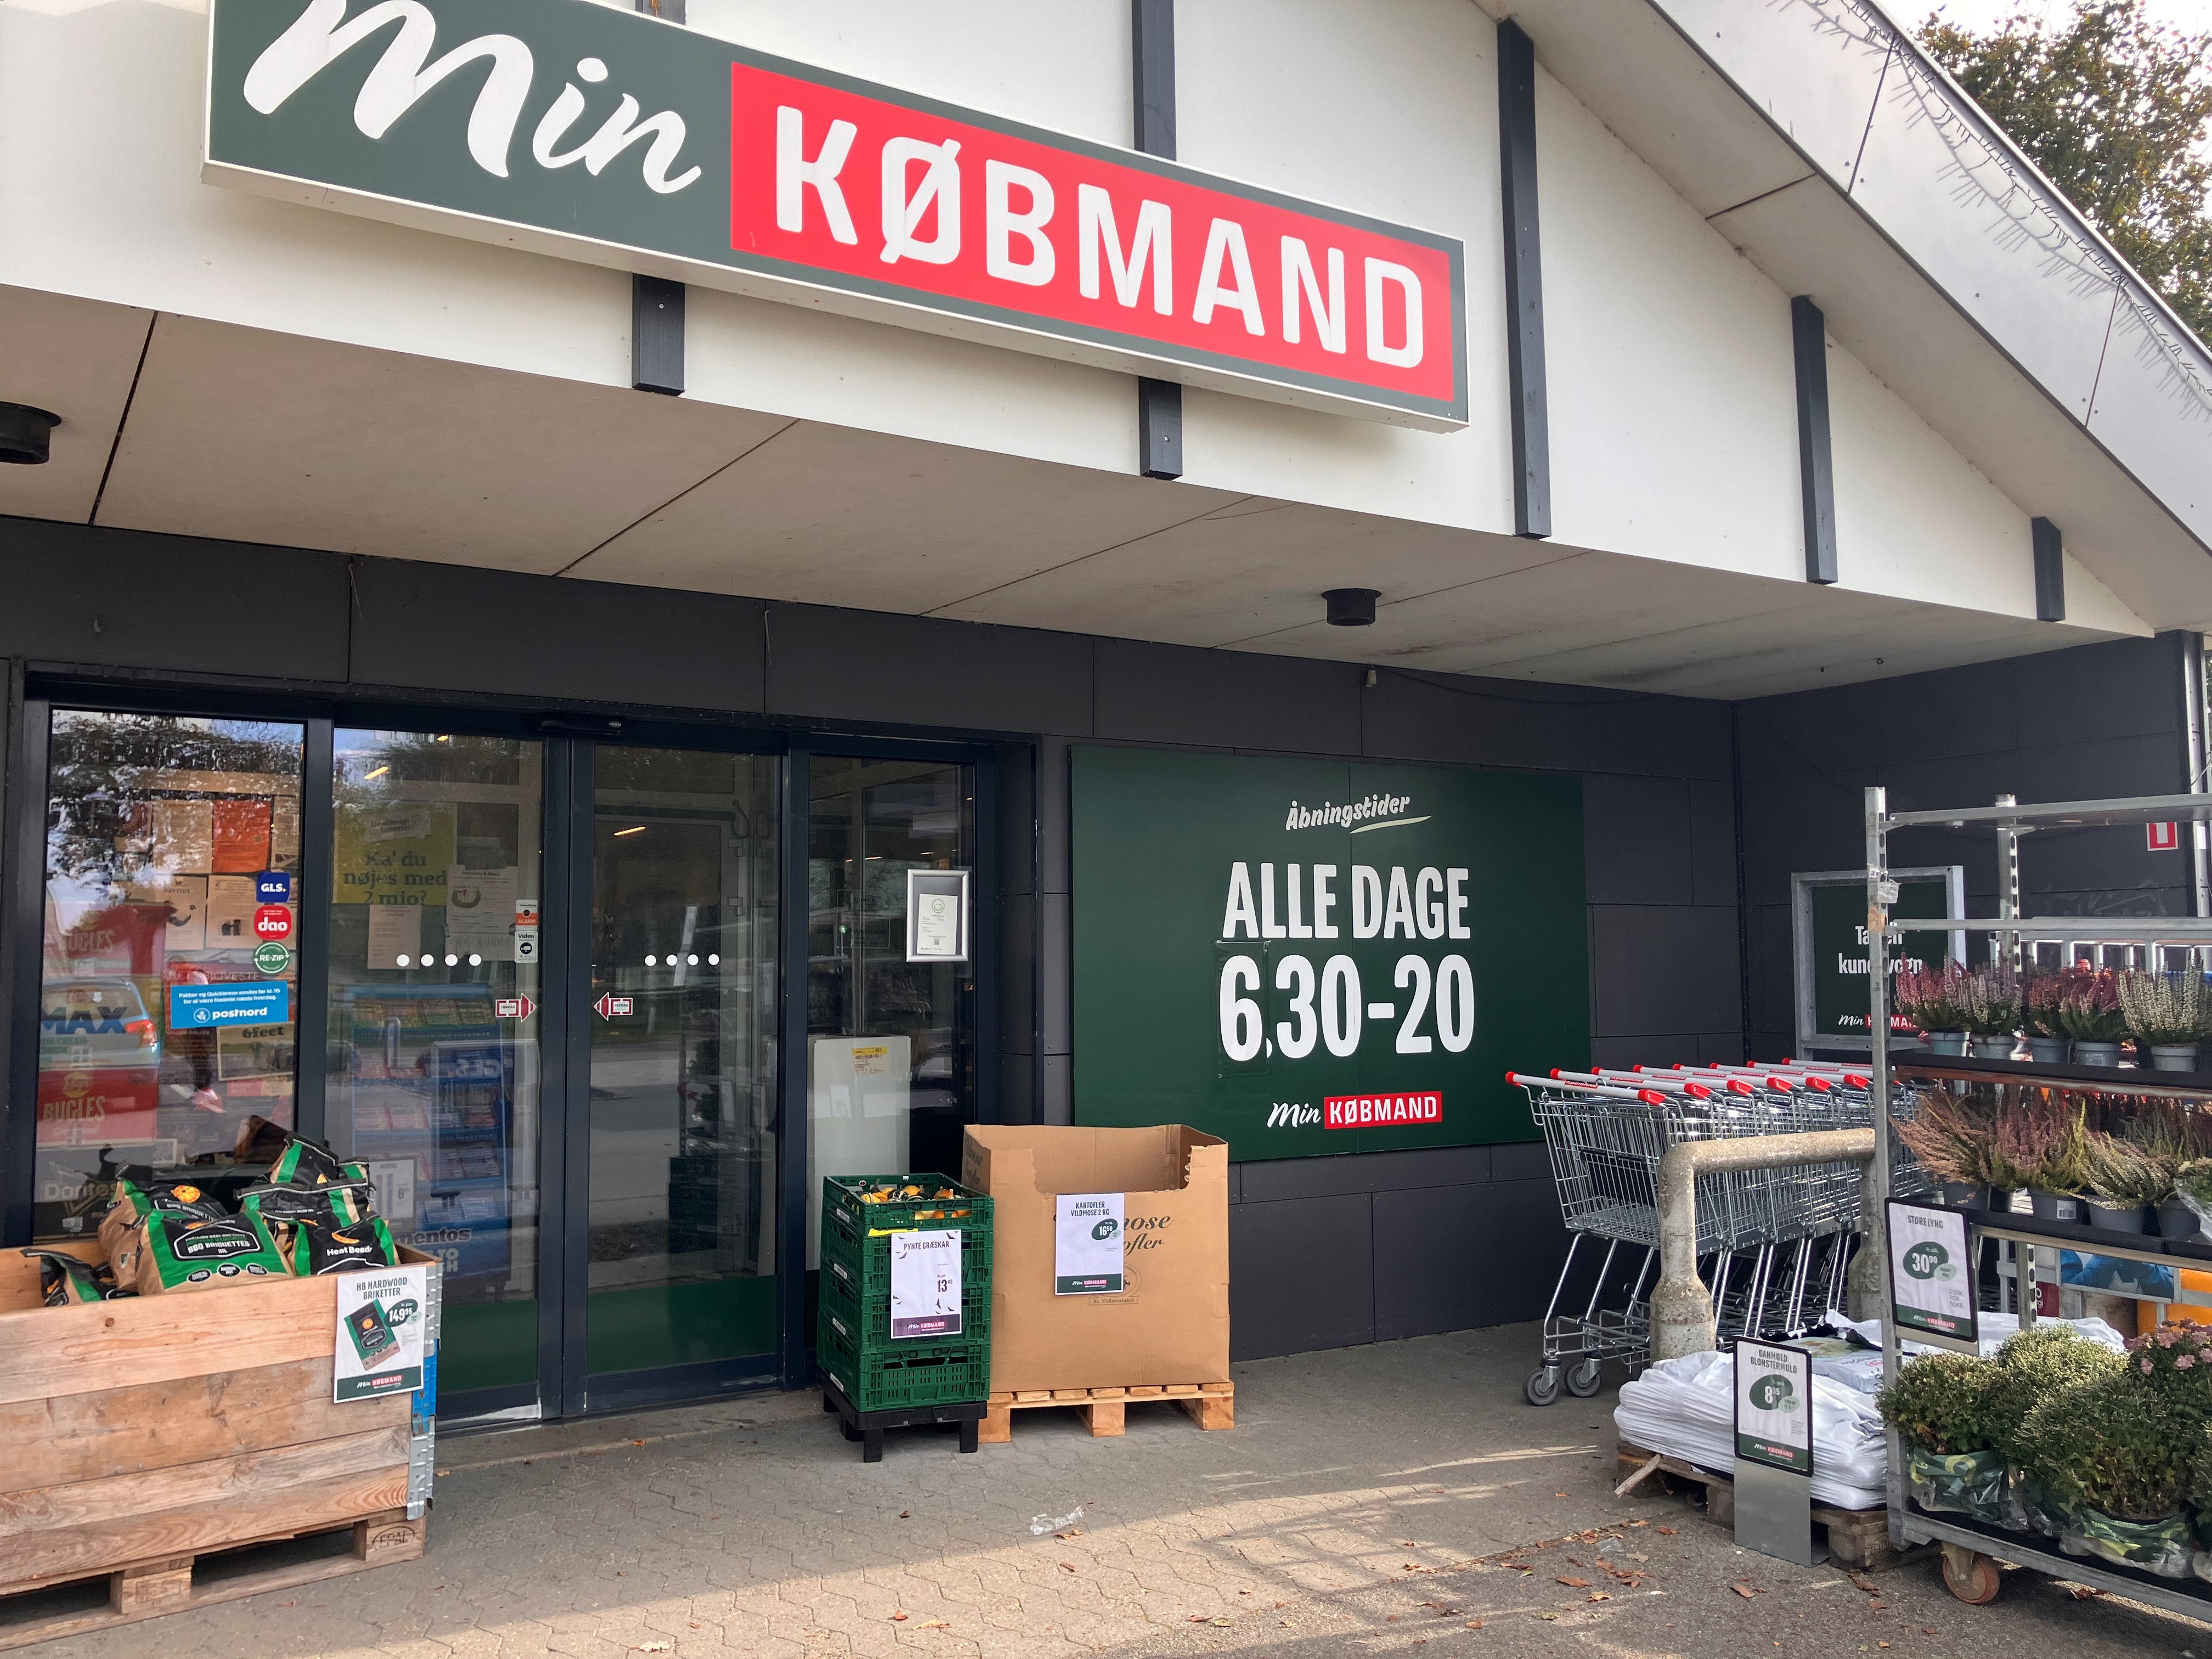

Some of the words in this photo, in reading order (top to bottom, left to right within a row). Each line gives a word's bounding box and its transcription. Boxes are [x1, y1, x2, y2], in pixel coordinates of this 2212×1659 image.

[244, 0, 702, 194] Min
[776, 105, 1424, 369] KØBMAND
[1285, 793, 1410, 831] Åbningstider
[402, 850, 427, 867] du
[343, 870, 398, 889] nøjes
[404, 870, 447, 885] med
[1222, 861, 1339, 939] ALLE
[1351, 864, 1471, 939] DAGE
[257, 916, 288, 932] dao
[212, 1007, 268, 1020] postnord
[1838, 1014, 1864, 1026] Min
[1266, 1102, 1321, 1128] Min
[1329, 1096, 1437, 1125] KØBMAND
[1075, 1201, 1105, 1209] KARTOFLER
[1908, 1215, 1927, 1227] STORE
[1927, 1218, 1944, 1229] LYNG
[326, 1248, 348, 1256] Heat
[904, 1242, 922, 1250] PYNTE
[922, 1240, 950, 1249] GRÆSKAR
[357, 1282, 366, 1291] HB
[368, 1277, 408, 1290] HARDWOOD
[363, 1287, 401, 1300] BRIKETTER
[1759, 1349, 1787, 1363] DANMULD
[1750, 1356, 1797, 1374] BLOMSTERMULD
